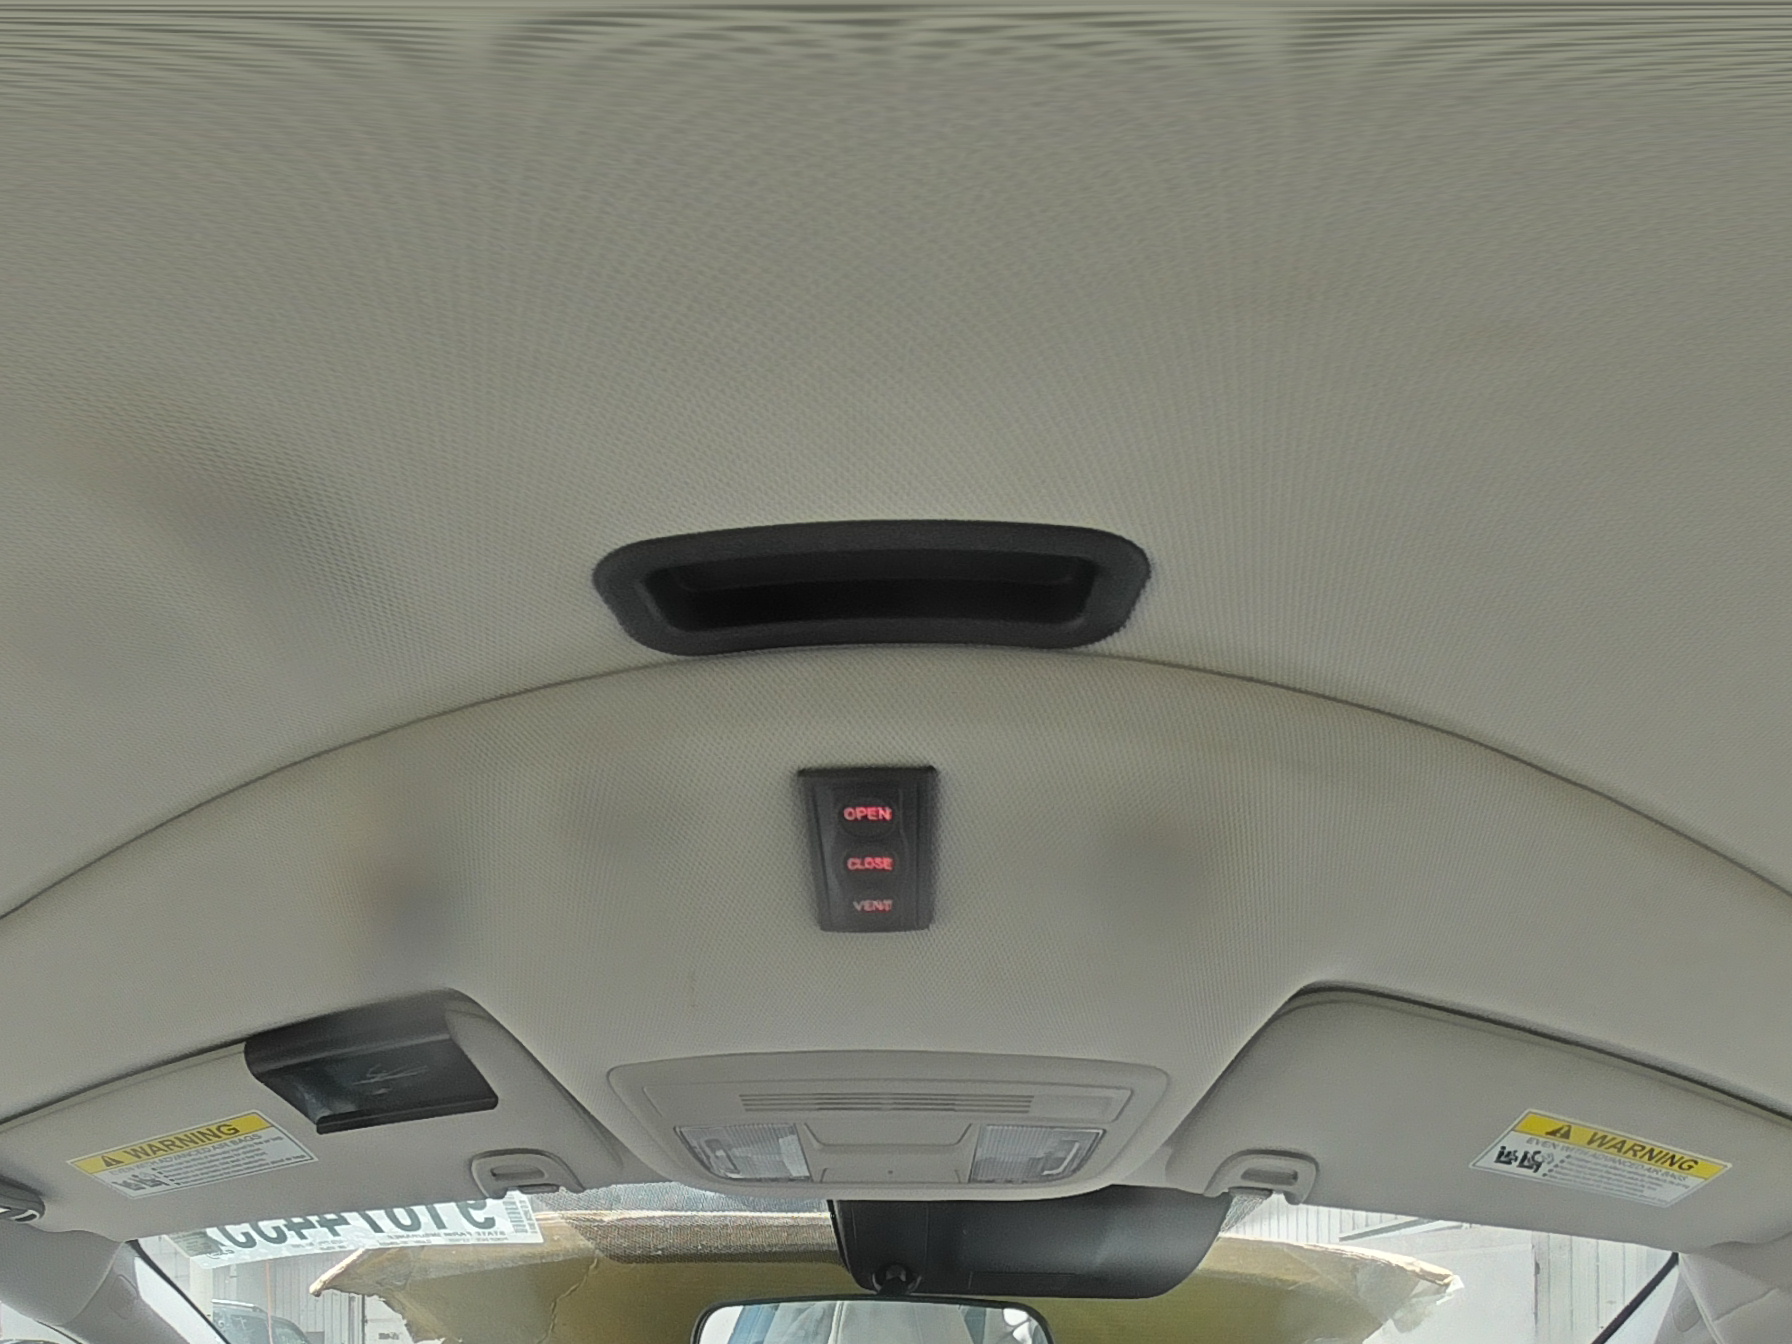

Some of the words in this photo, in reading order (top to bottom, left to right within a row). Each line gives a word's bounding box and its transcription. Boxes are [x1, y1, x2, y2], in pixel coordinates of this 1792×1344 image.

[843, 806, 893, 820] OPEN
[846, 857, 893, 870] CLOSE
[852, 899, 893, 912] VENT
[124, 1123, 240, 1158] WARNING
[1587, 1131, 1699, 1171] WARNING
